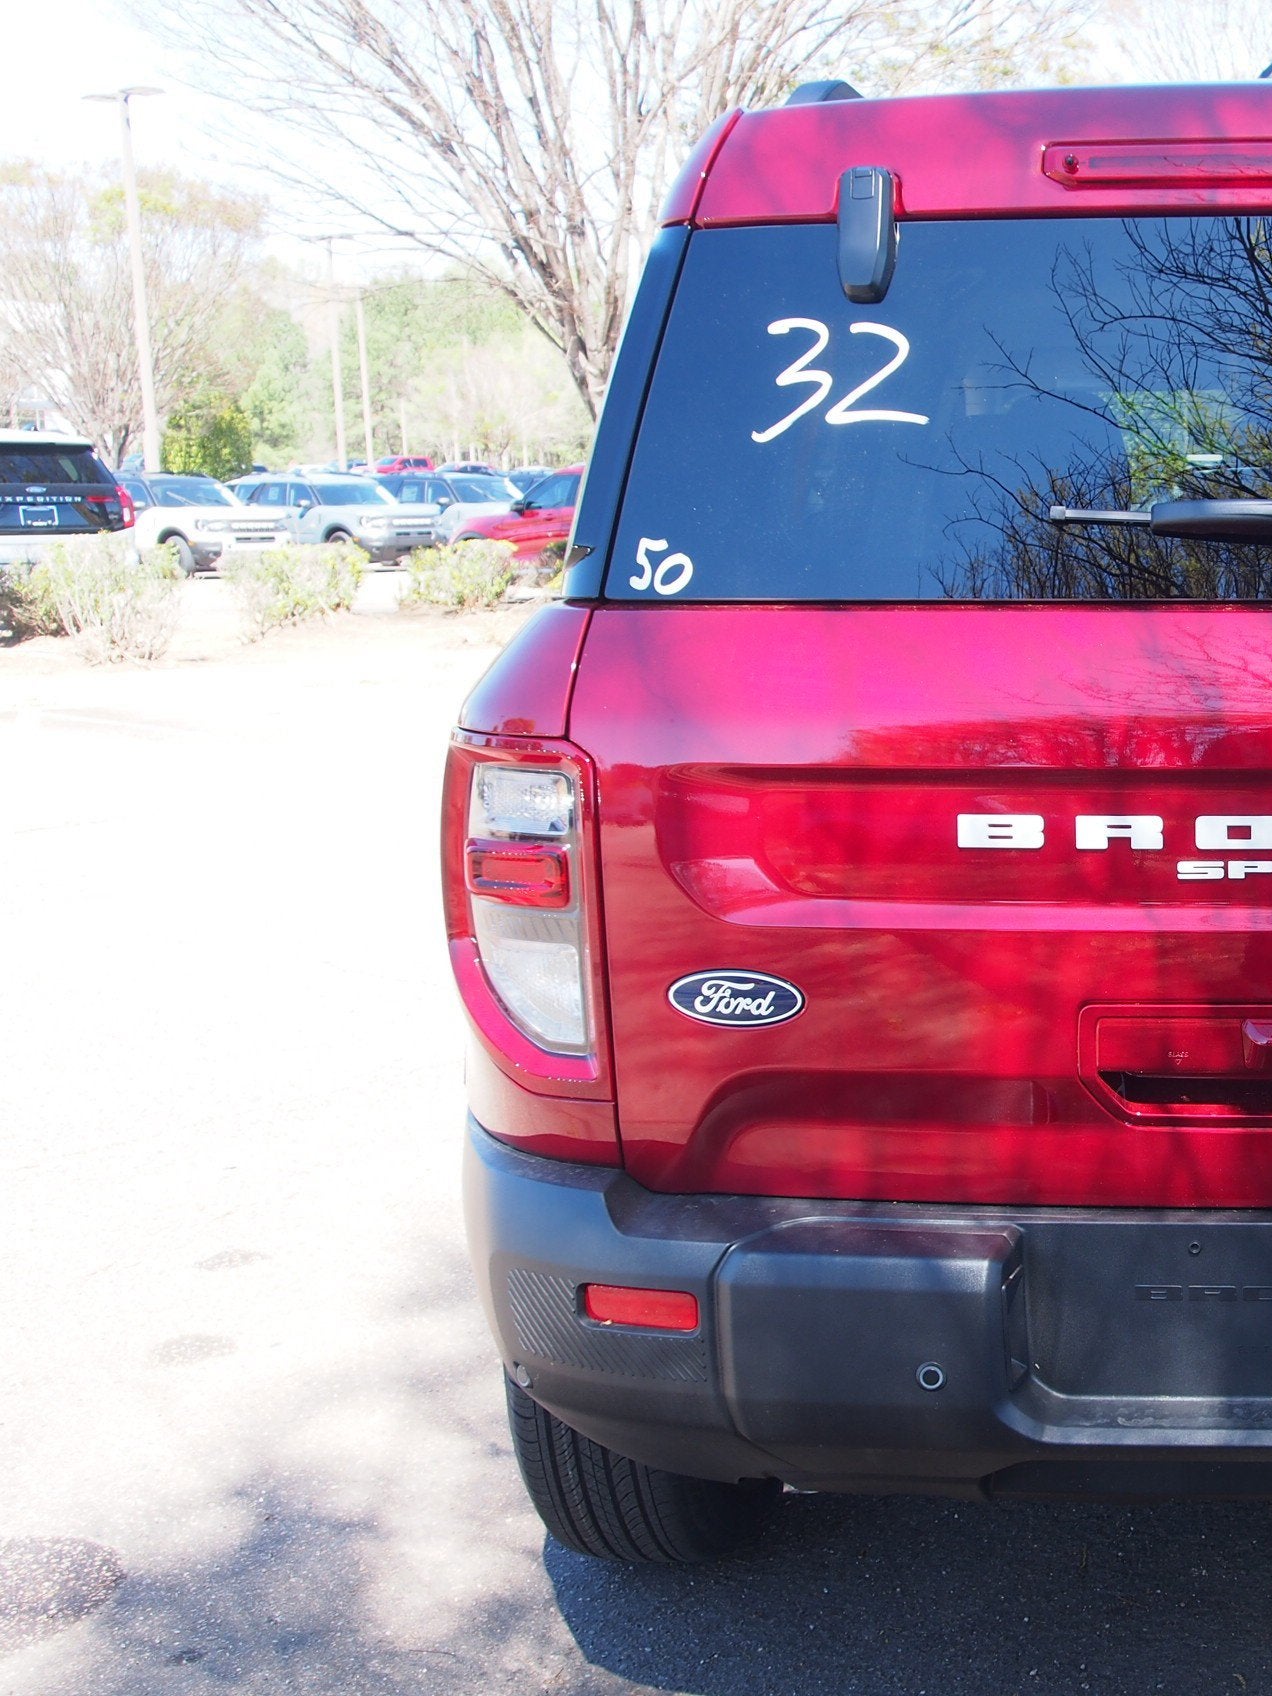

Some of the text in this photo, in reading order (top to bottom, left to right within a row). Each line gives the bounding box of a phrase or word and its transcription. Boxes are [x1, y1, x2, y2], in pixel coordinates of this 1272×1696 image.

[751, 317, 930, 443] 32
[629, 537, 694, 595] 50
[693, 979, 776, 1017] Ford
